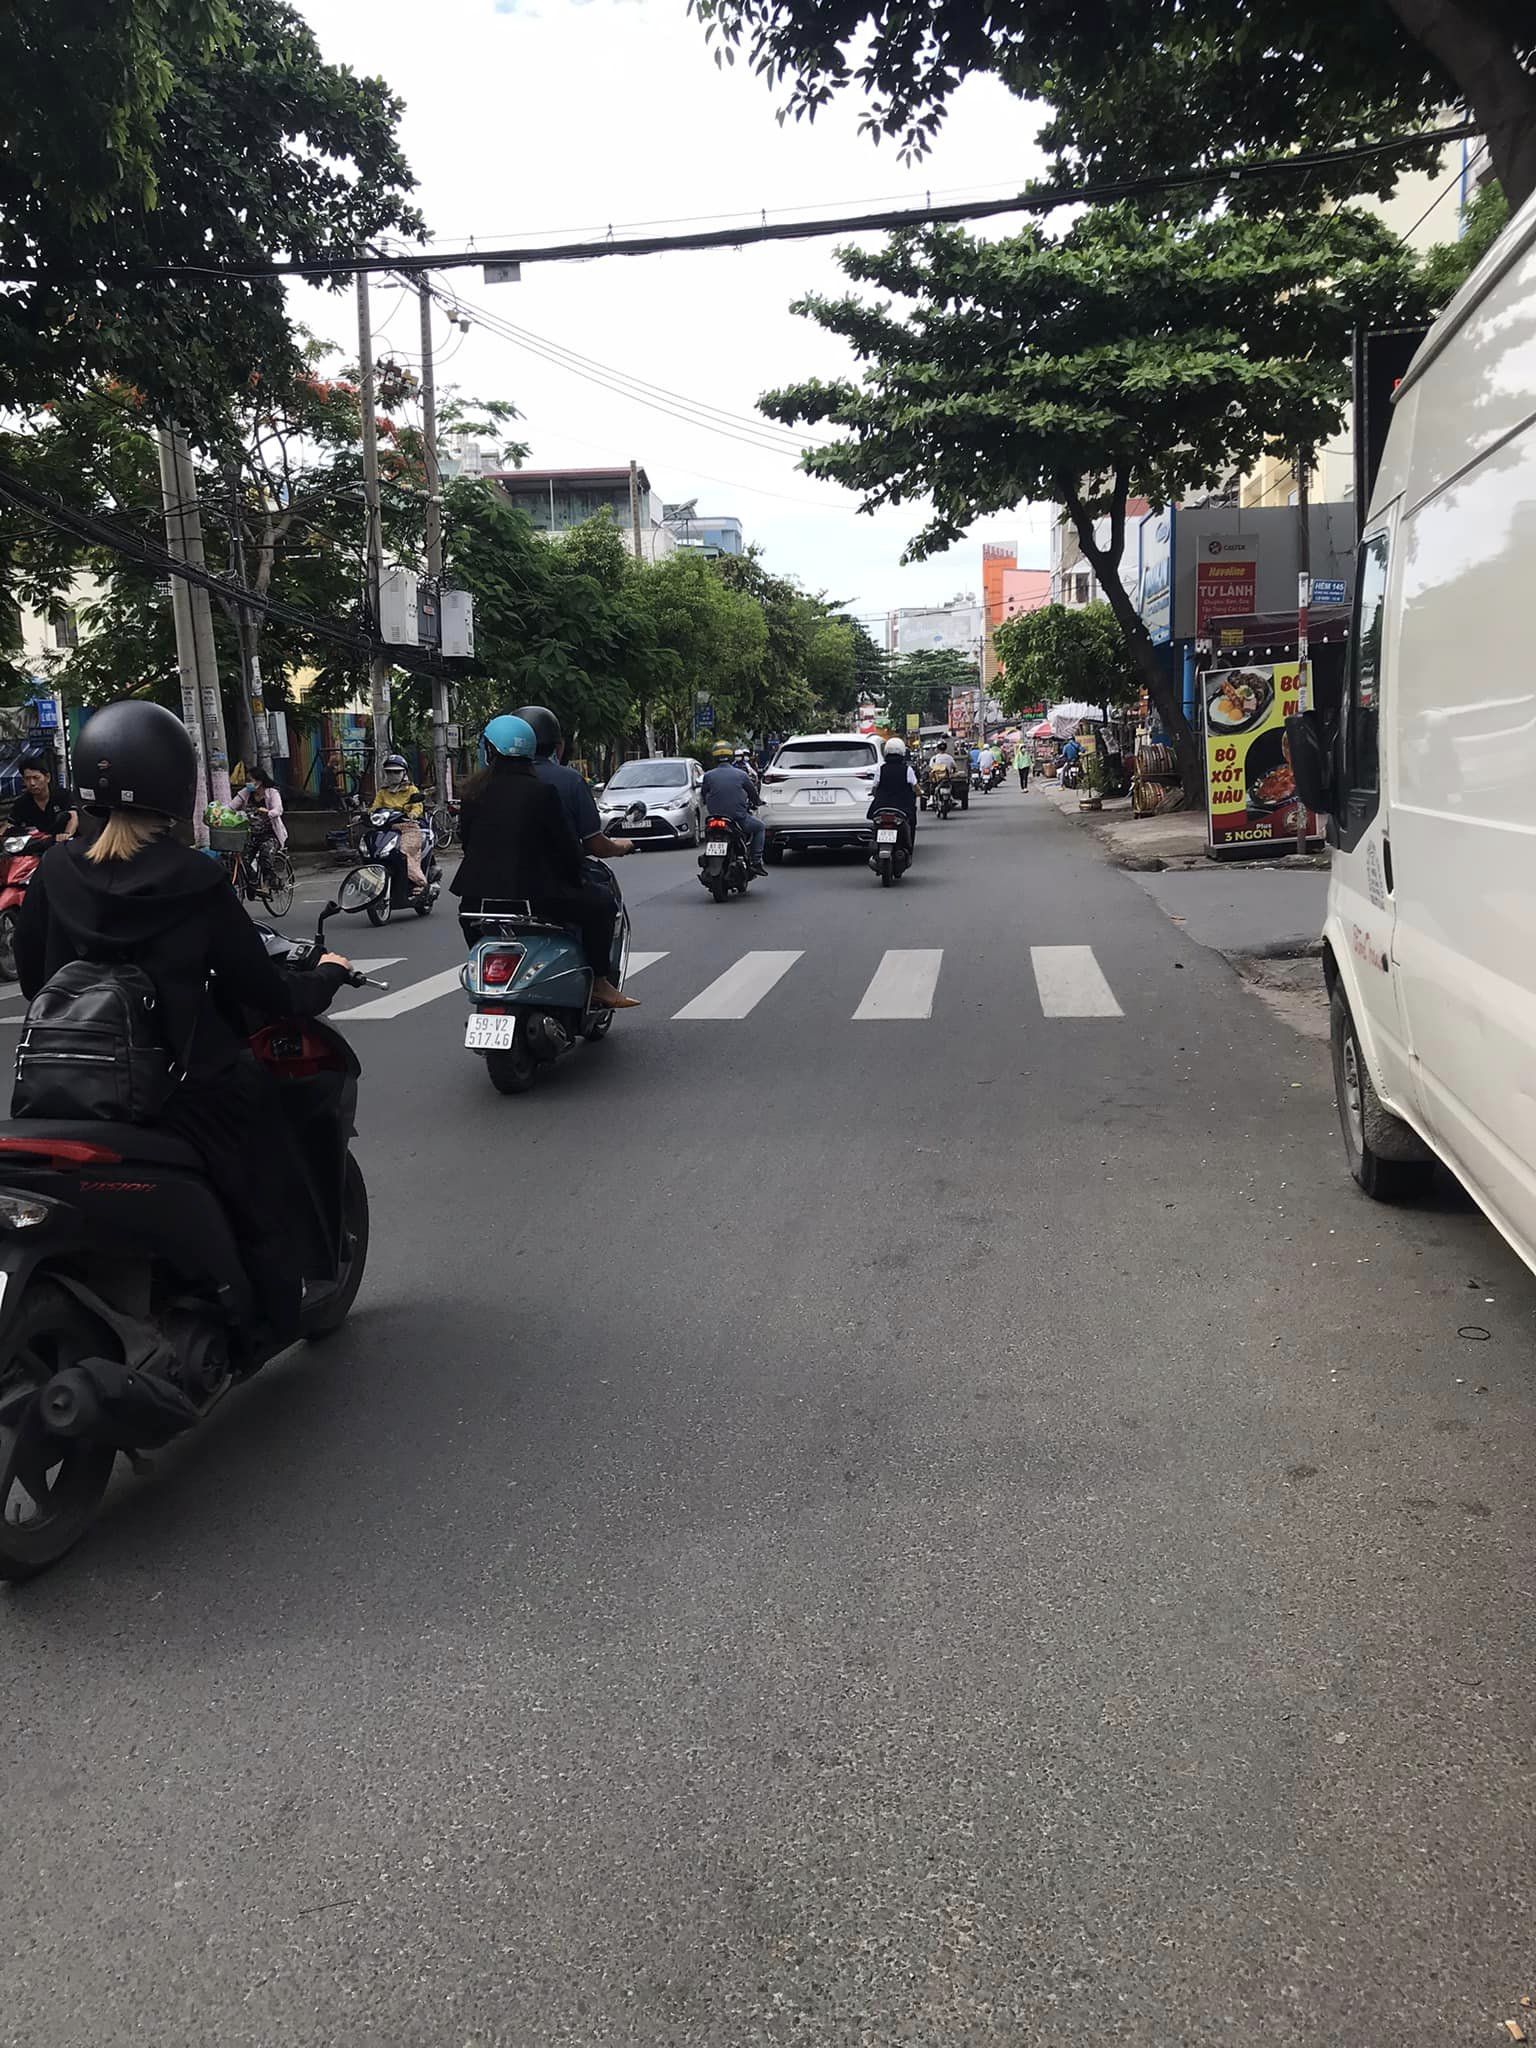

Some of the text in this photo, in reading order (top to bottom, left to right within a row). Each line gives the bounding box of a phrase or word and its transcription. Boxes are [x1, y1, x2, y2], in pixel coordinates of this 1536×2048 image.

[1215, 744, 1237, 763] BÒ
[1211, 762, 1244, 783] XỐT
[1212, 786, 1244, 805] HÀU
[1224, 832, 1233, 842] 3
[475, 1017, 508, 1032] 59-V2
[468, 1031, 511, 1047] 517.46
